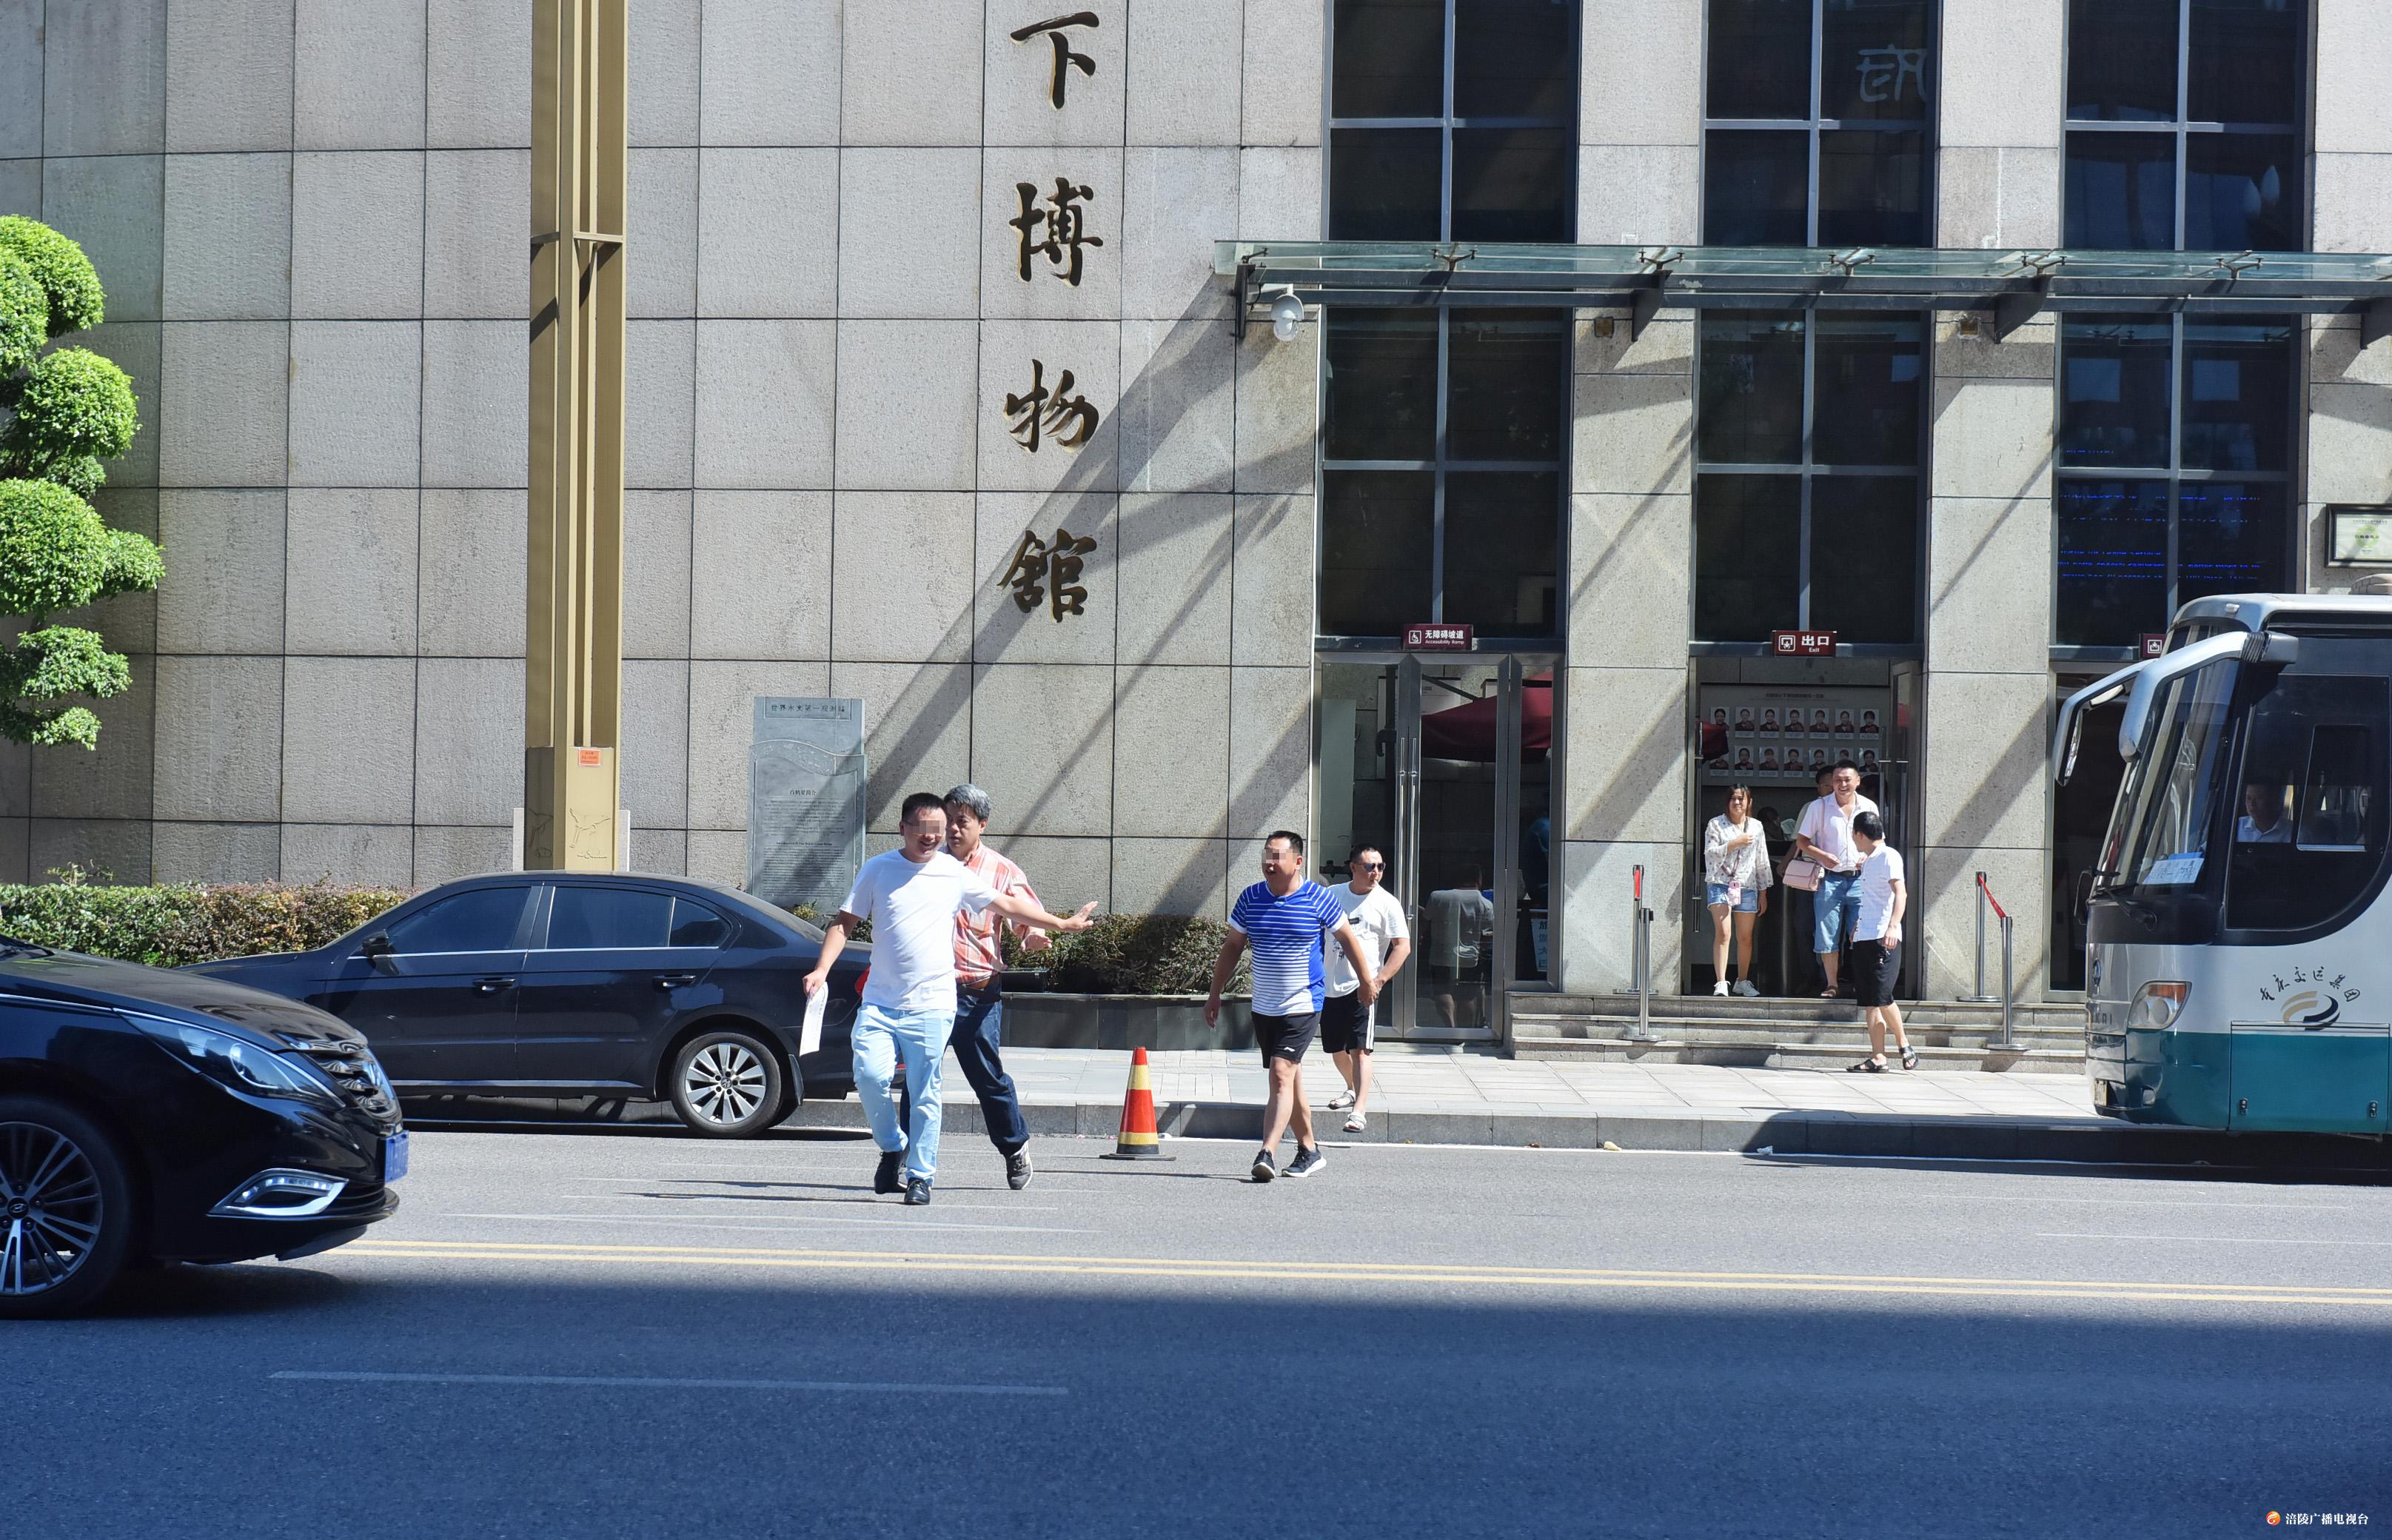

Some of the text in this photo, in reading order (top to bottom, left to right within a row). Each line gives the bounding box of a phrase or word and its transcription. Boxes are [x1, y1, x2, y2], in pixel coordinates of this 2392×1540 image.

[1424, 629, 1464, 639] 无障碍坡道
[1801, 635, 1829, 646] 出口
